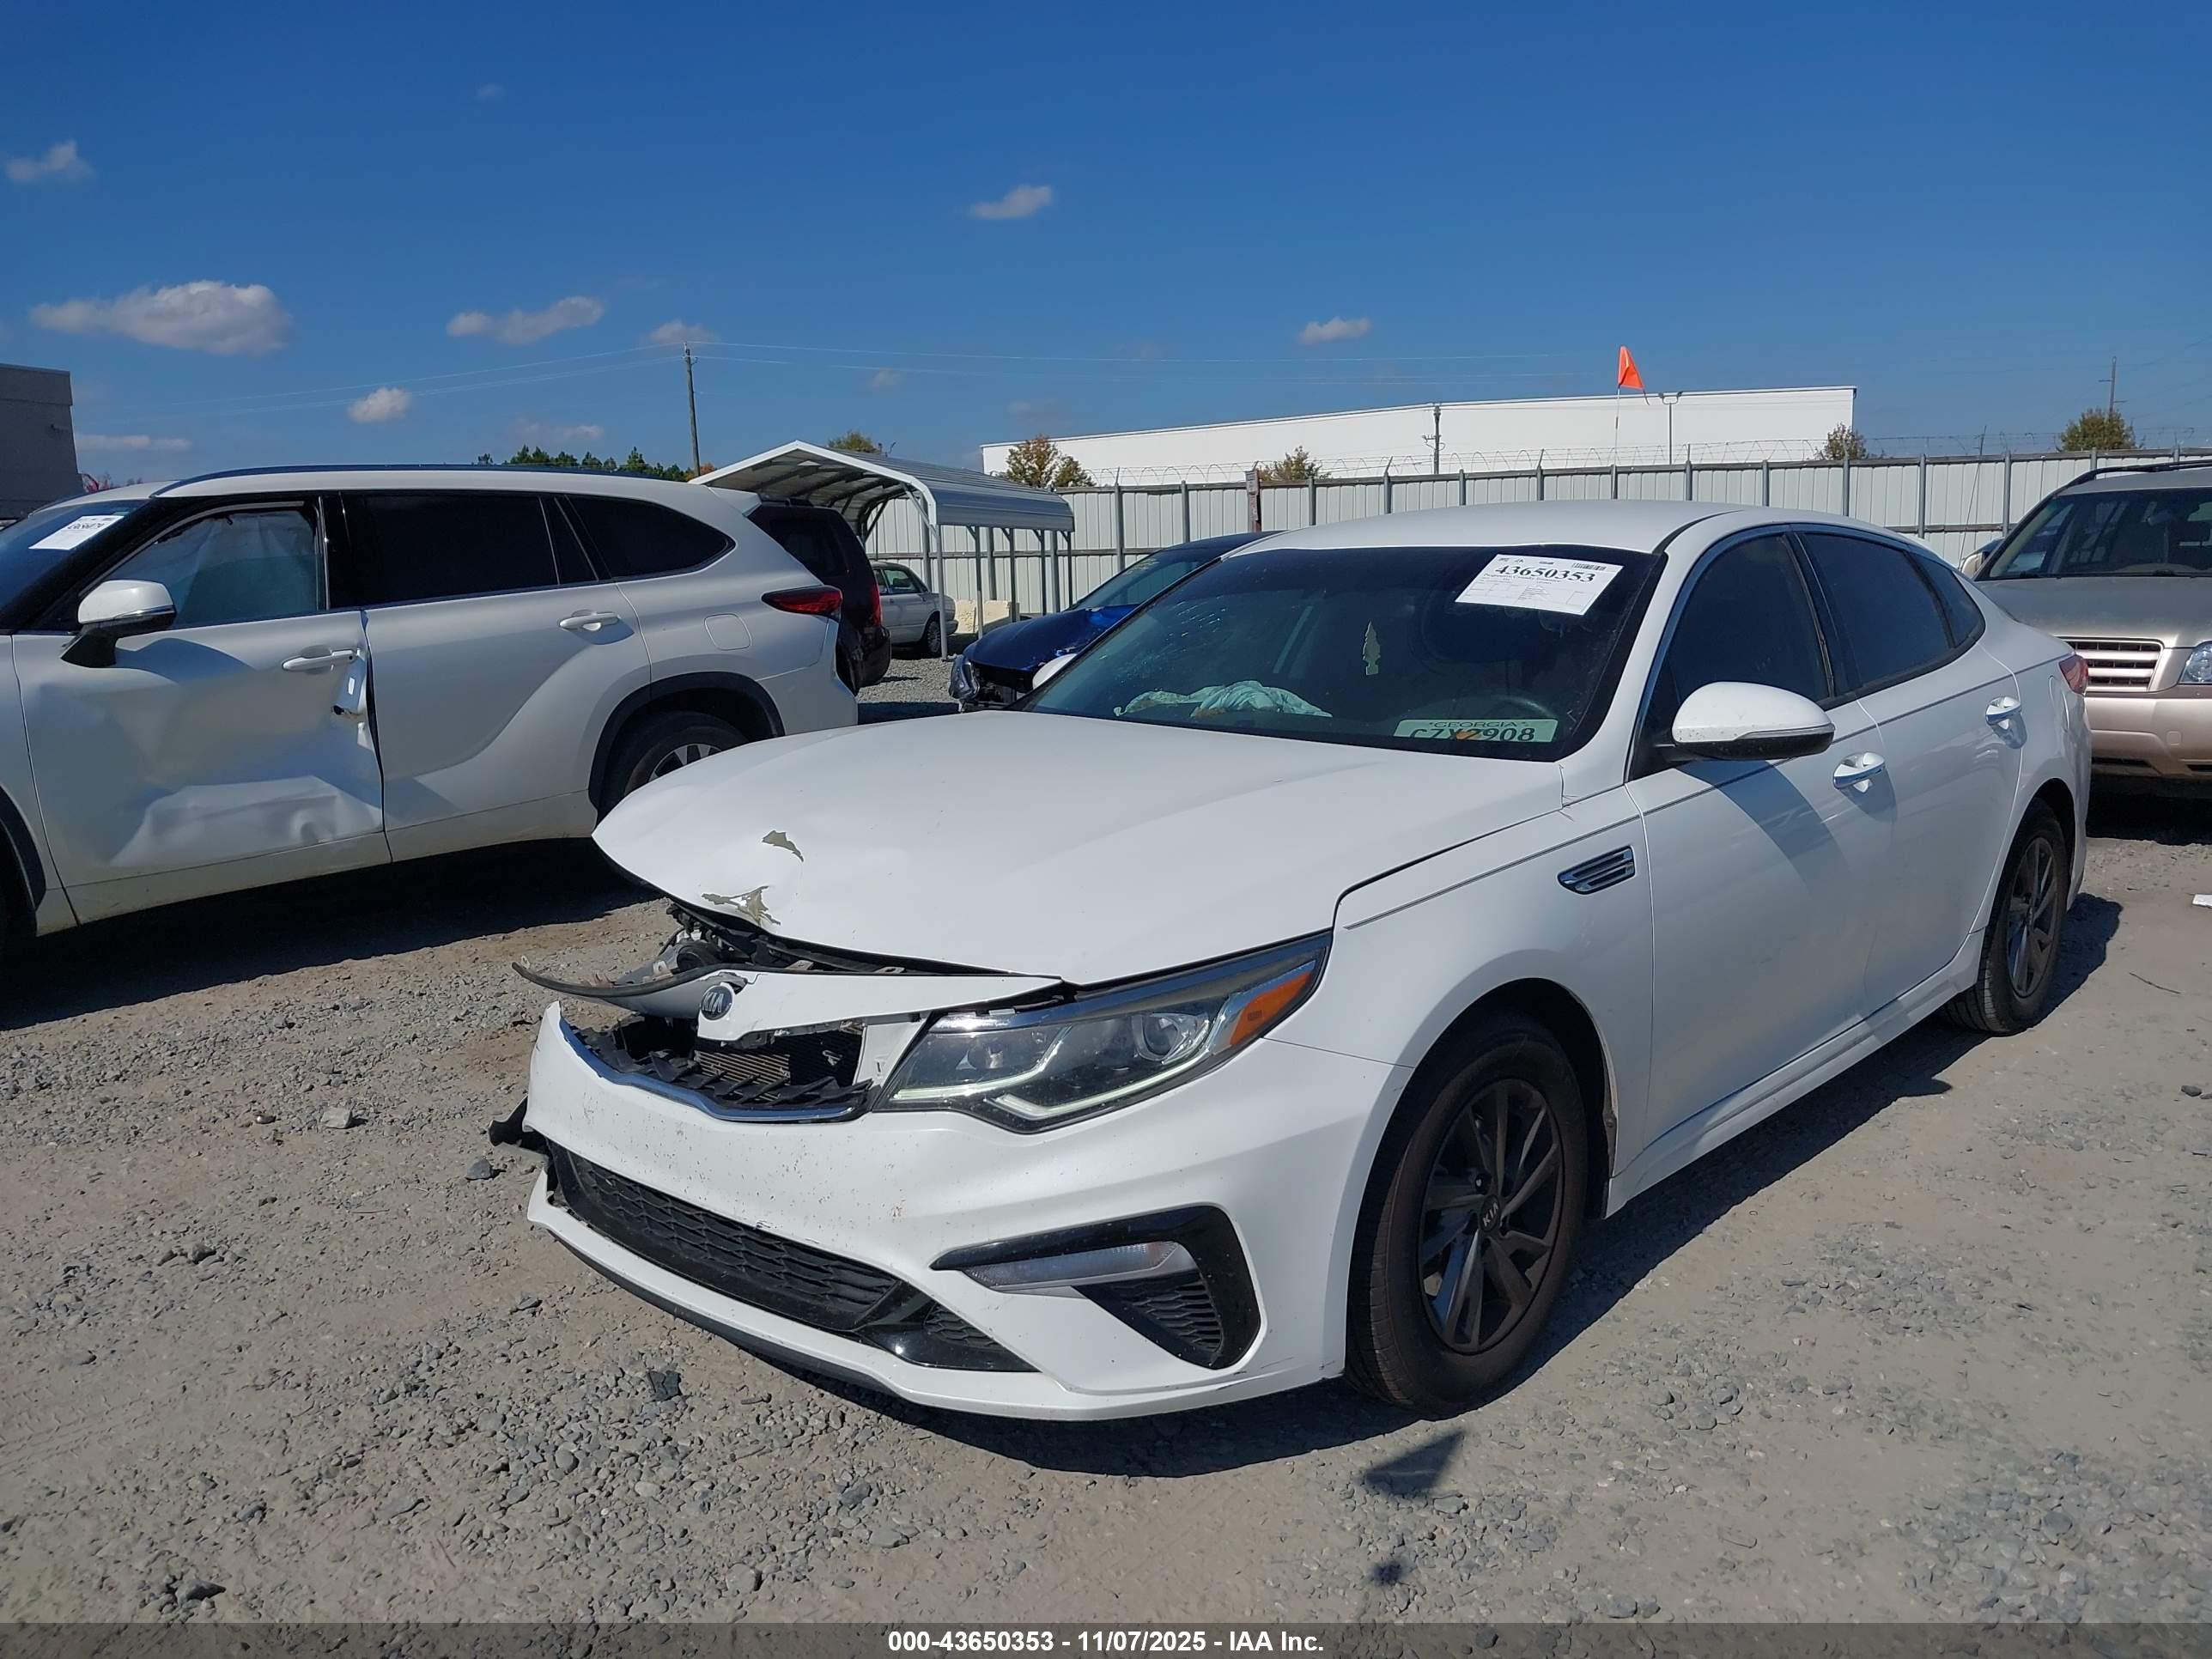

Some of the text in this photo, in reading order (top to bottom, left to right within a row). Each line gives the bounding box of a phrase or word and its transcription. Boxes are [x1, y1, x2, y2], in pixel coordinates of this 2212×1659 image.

[1495, 564, 1595, 583] 43650353
[702, 991, 725, 1013] KIA
[1482, 1202, 1499, 1227] KIA
